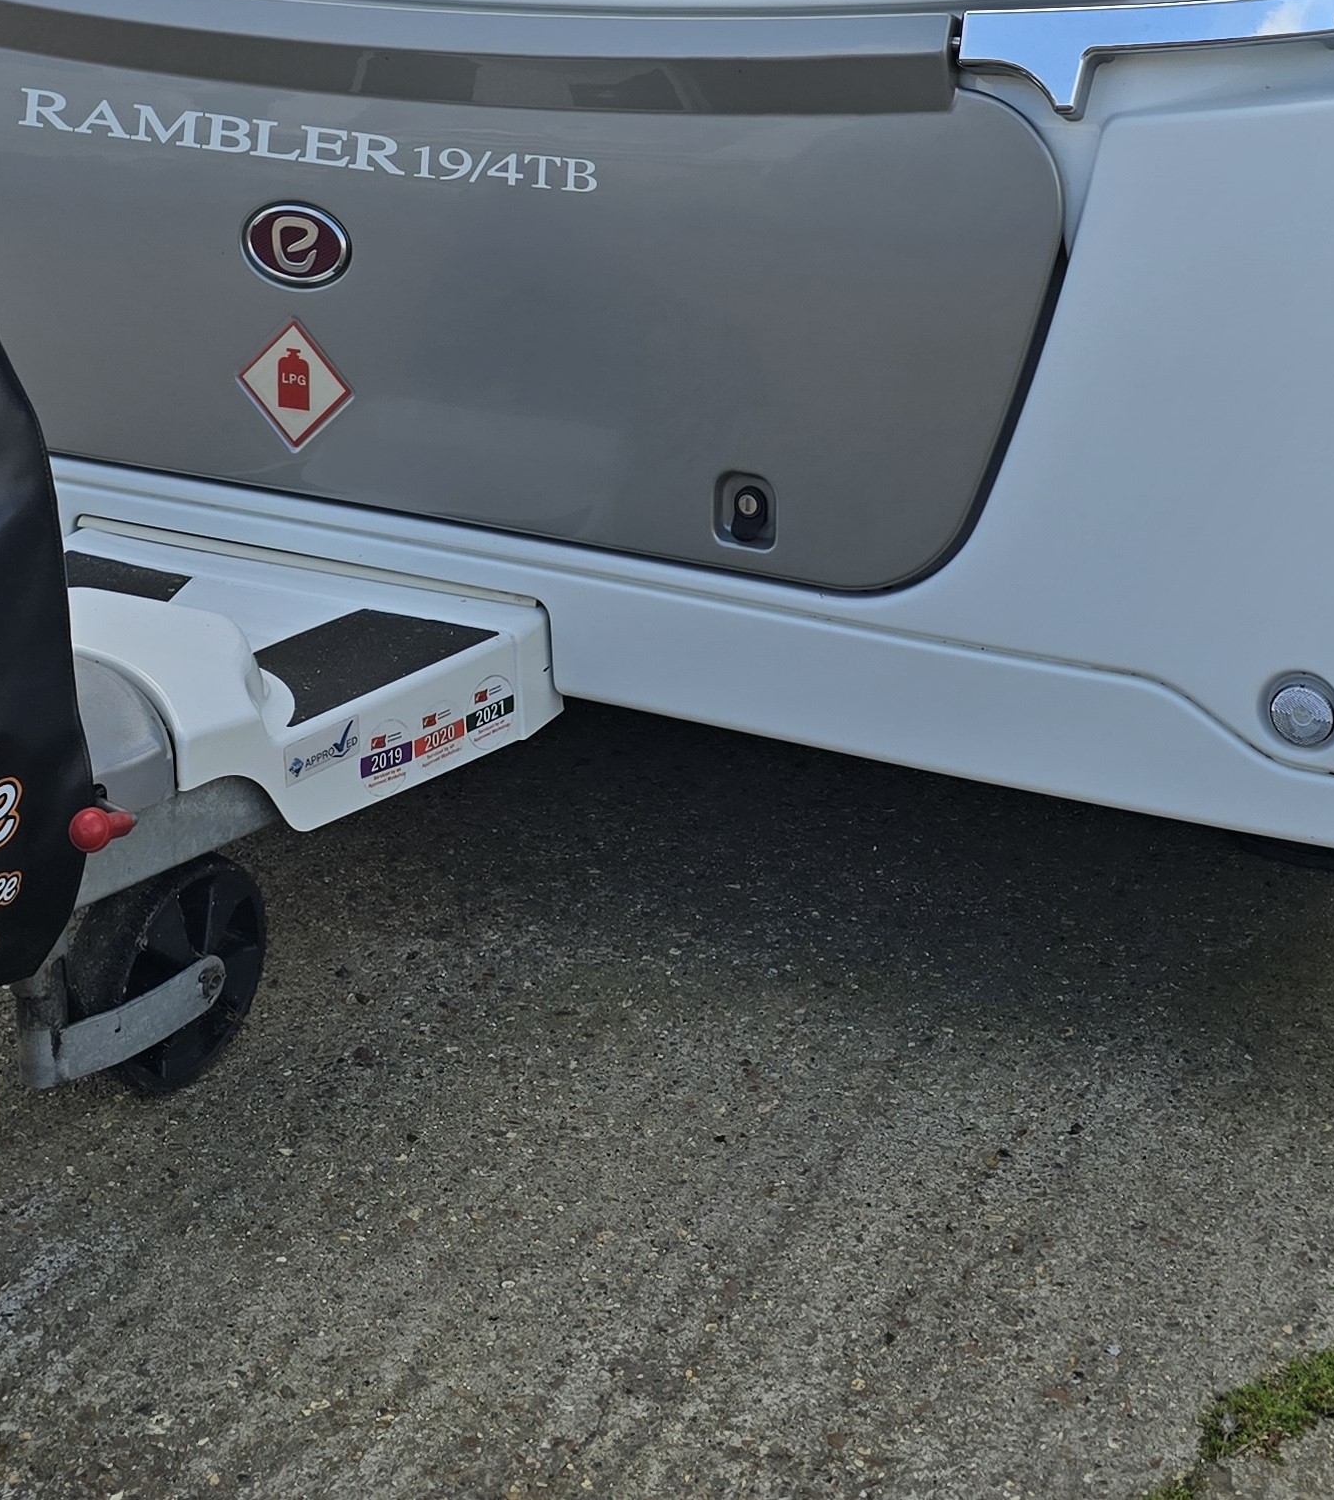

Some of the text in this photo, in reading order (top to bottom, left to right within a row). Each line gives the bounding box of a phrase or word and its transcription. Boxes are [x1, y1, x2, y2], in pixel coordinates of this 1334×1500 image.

[17, 87, 598, 192] RAMBLER 19/4TB
[281, 372, 307, 386] LPG
[475, 700, 505, 727] 2021
[424, 724, 455, 752] 2020
[370, 747, 403, 773] 2019
